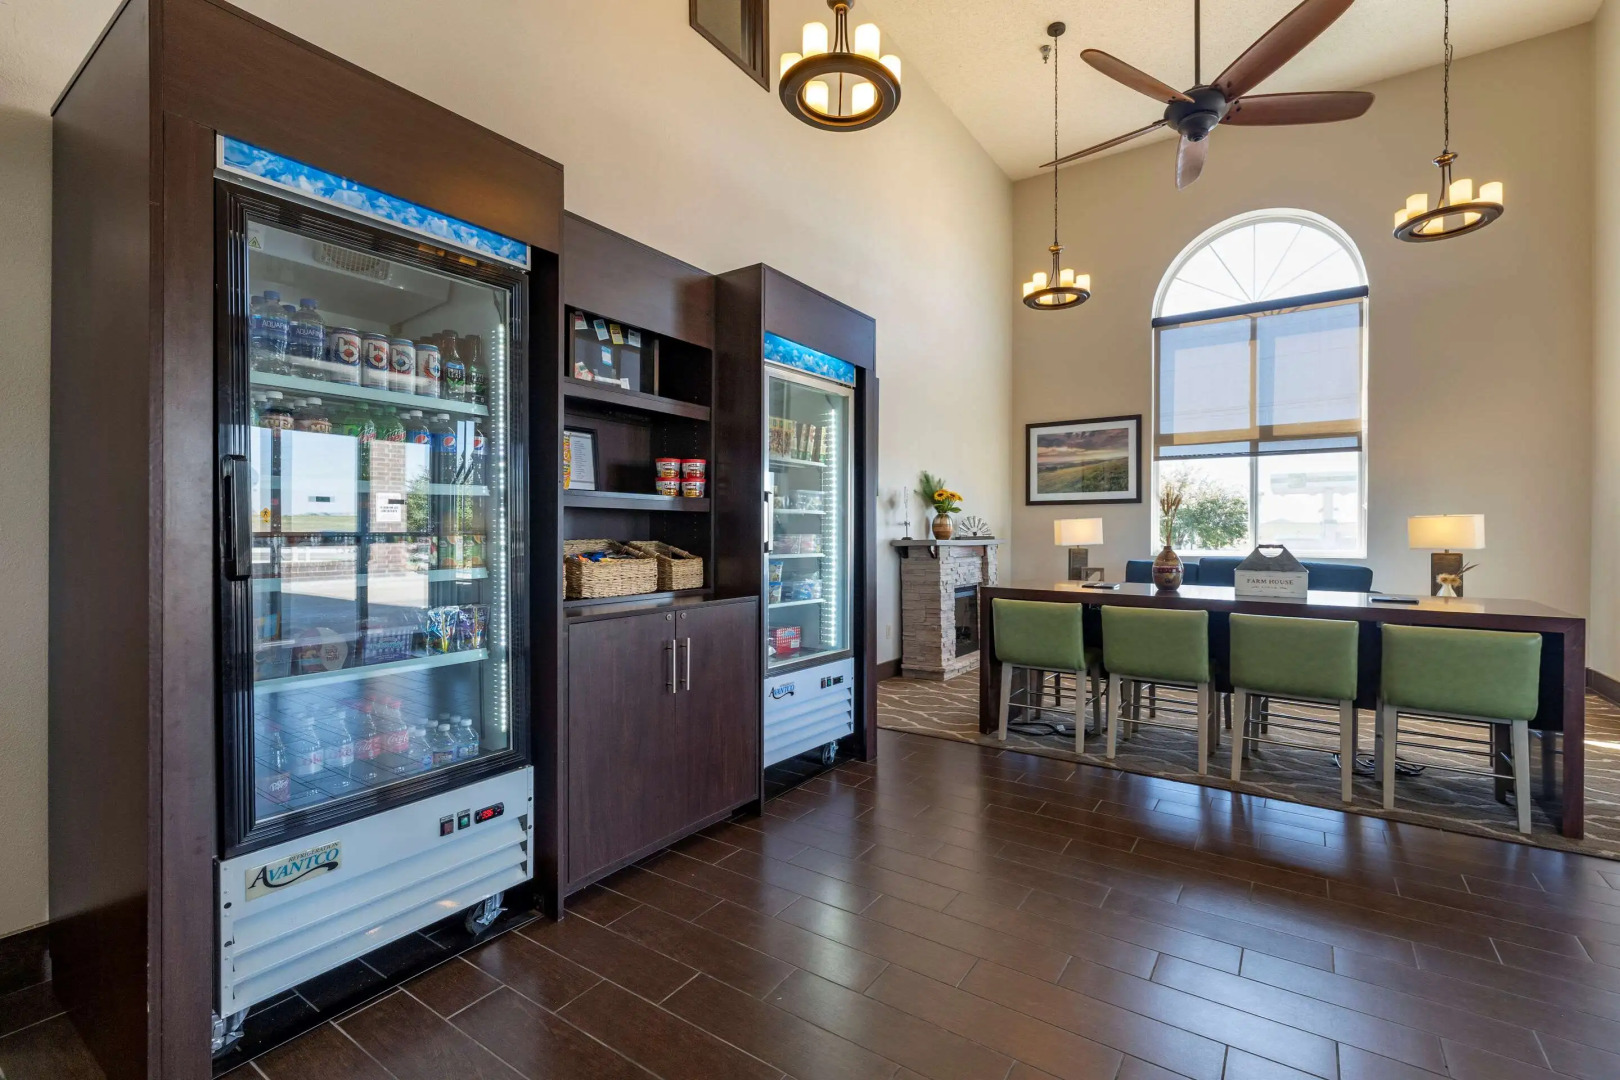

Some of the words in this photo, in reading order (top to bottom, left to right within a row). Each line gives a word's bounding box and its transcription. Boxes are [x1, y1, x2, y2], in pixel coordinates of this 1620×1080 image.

[261, 319, 290, 332] AQUAFIN
[288, 842, 339, 862] REFRIGERATION
[247, 848, 339, 889] AVANTCO
